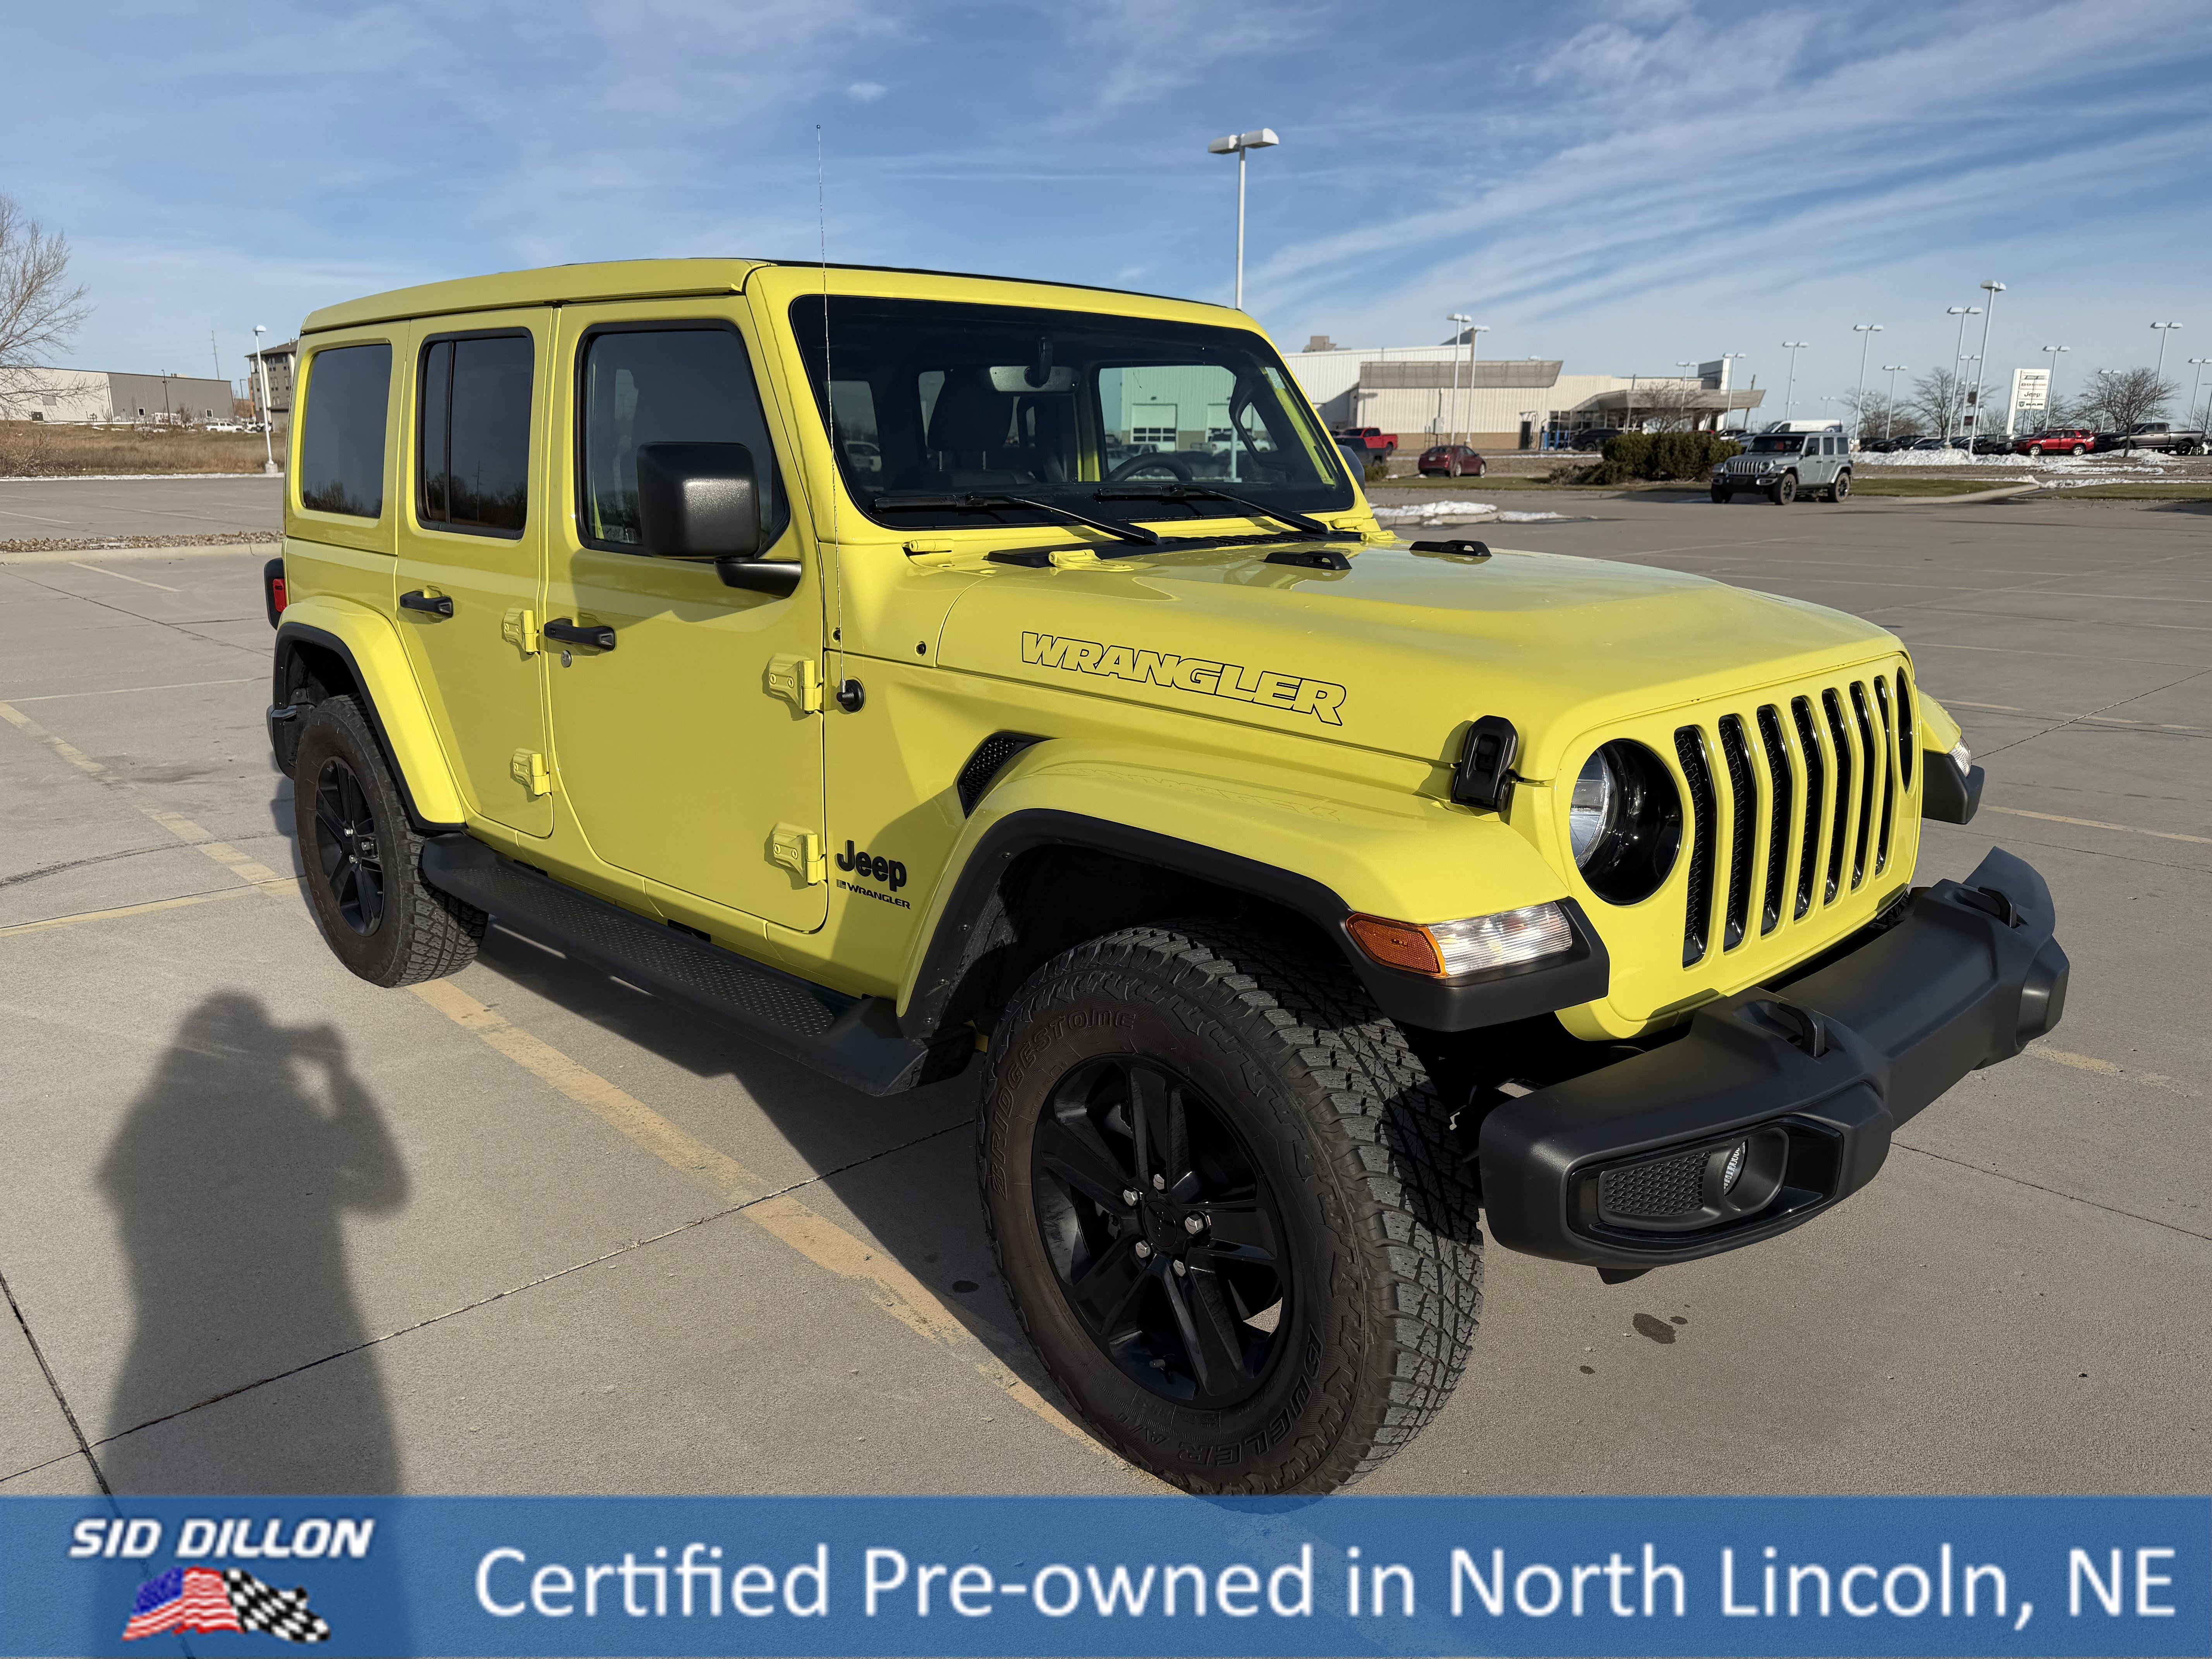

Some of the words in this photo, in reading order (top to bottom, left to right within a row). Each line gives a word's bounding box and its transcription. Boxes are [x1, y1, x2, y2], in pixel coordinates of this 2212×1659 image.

[1022, 631, 1346, 726] WRANGLER
[835, 840, 907, 892] Jeep
[847, 882, 910, 910] WRANGLER
[1178, 1323, 1323, 1466] DUELER
